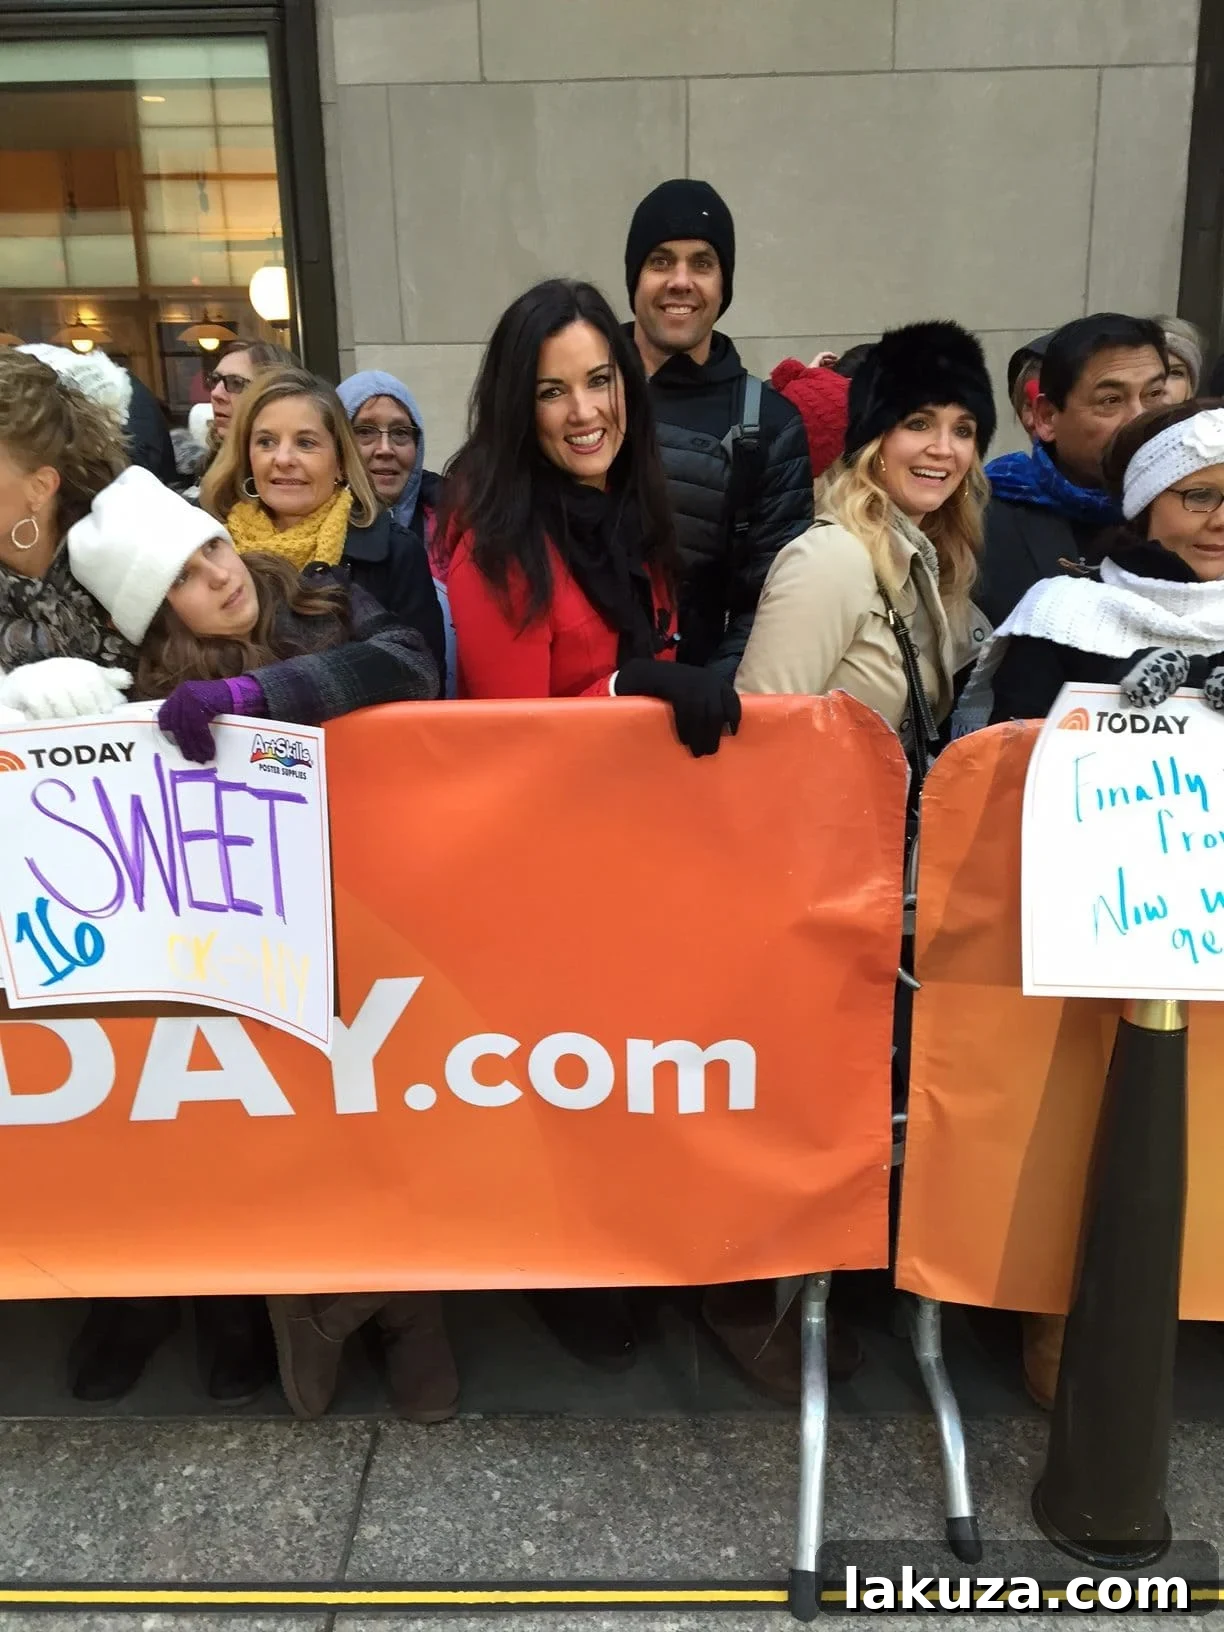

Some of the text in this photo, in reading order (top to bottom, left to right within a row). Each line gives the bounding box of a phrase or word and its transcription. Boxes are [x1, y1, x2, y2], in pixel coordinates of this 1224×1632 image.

[1096, 711, 1190, 734] TODAY
[28, 741, 136, 769] TODAY
[251, 733, 312, 762] ArtSkills
[259, 763, 307, 780] POSTER SUPPLIES
[1073, 752, 1209, 823] Finally
[24, 752, 308, 925] SWEET
[16, 897, 105, 986] 16
